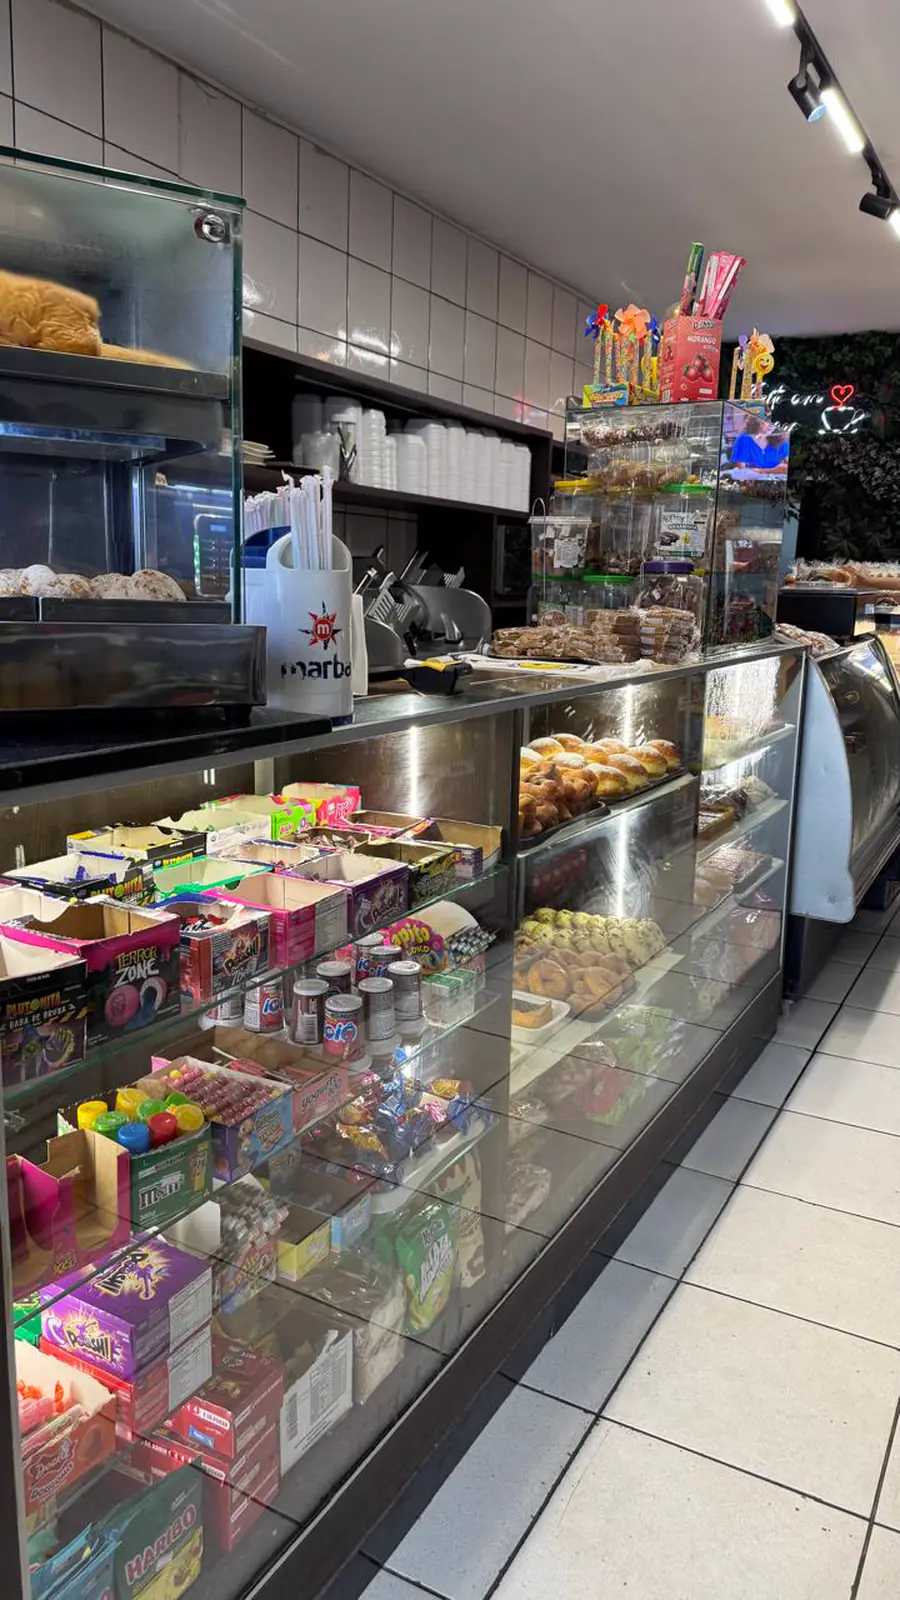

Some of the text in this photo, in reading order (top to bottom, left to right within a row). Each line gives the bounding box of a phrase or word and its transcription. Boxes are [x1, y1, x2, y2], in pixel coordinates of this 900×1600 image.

[114, 946, 158, 970] TERROR
[114, 958, 160, 987] ZONE
[125, 1503, 198, 1585] HARIBO
